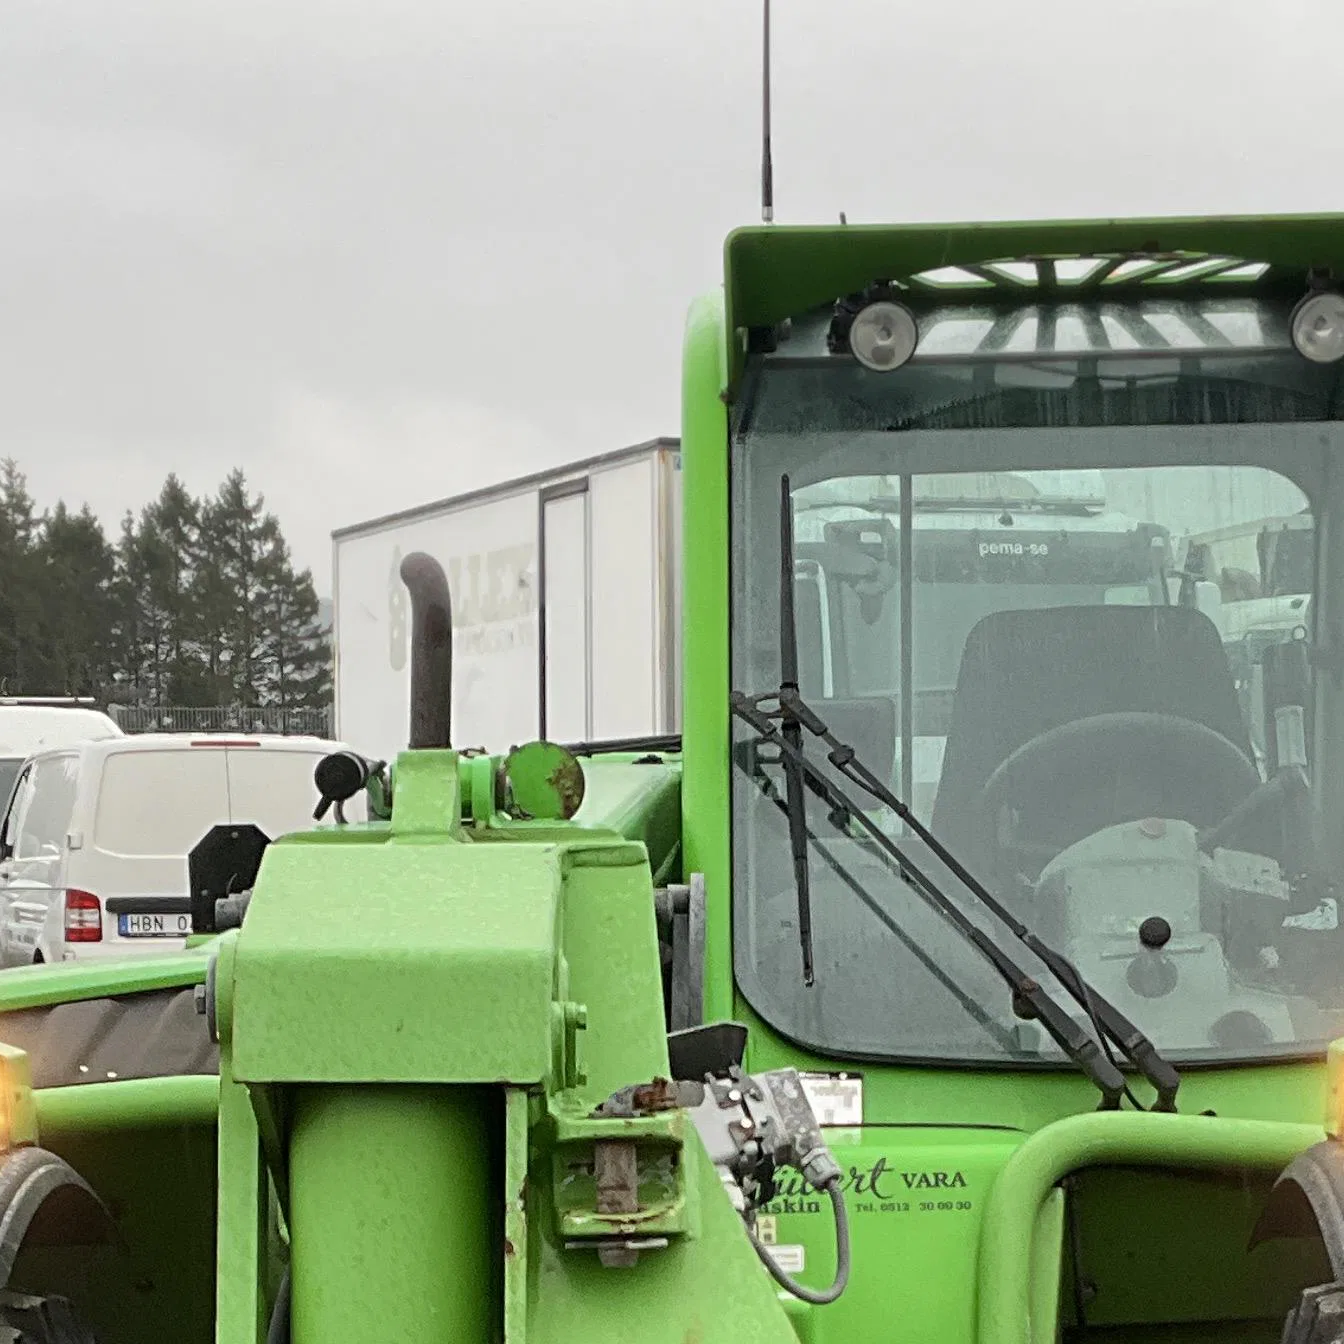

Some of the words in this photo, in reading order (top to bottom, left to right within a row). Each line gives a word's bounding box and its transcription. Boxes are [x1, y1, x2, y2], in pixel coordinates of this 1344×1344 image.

[130, 915, 164, 931] HBN
[900, 1171, 967, 1189] VARA
[758, 1198, 820, 1213] askin
